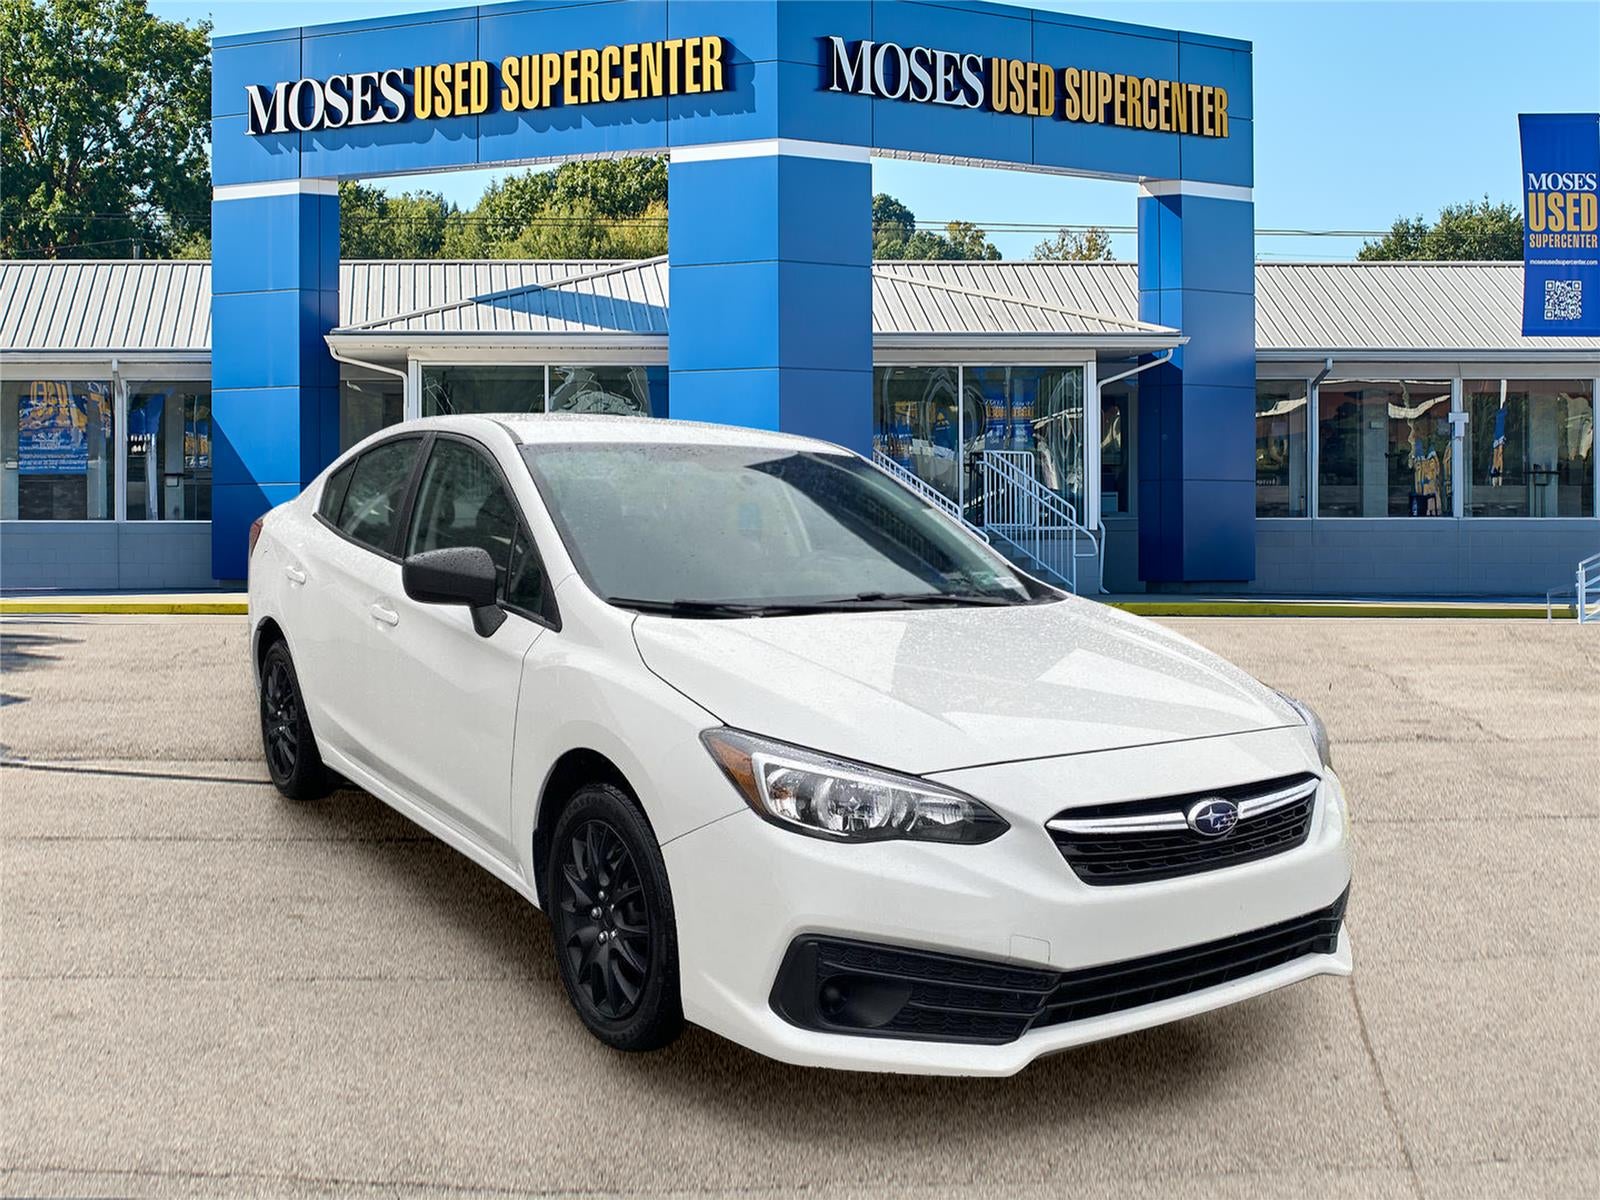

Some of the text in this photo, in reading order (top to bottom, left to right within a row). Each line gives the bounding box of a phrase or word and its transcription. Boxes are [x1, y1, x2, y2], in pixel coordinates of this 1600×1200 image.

[244, 35, 724, 135] MOSES USED SUPERCENTER
[829, 35, 1229, 138] MOSES USED SUPERCENTER
[1527, 172, 1598, 191] MOSES
[1528, 192, 1598, 232] USED
[1529, 233, 1598, 249] SUPERCENTER
